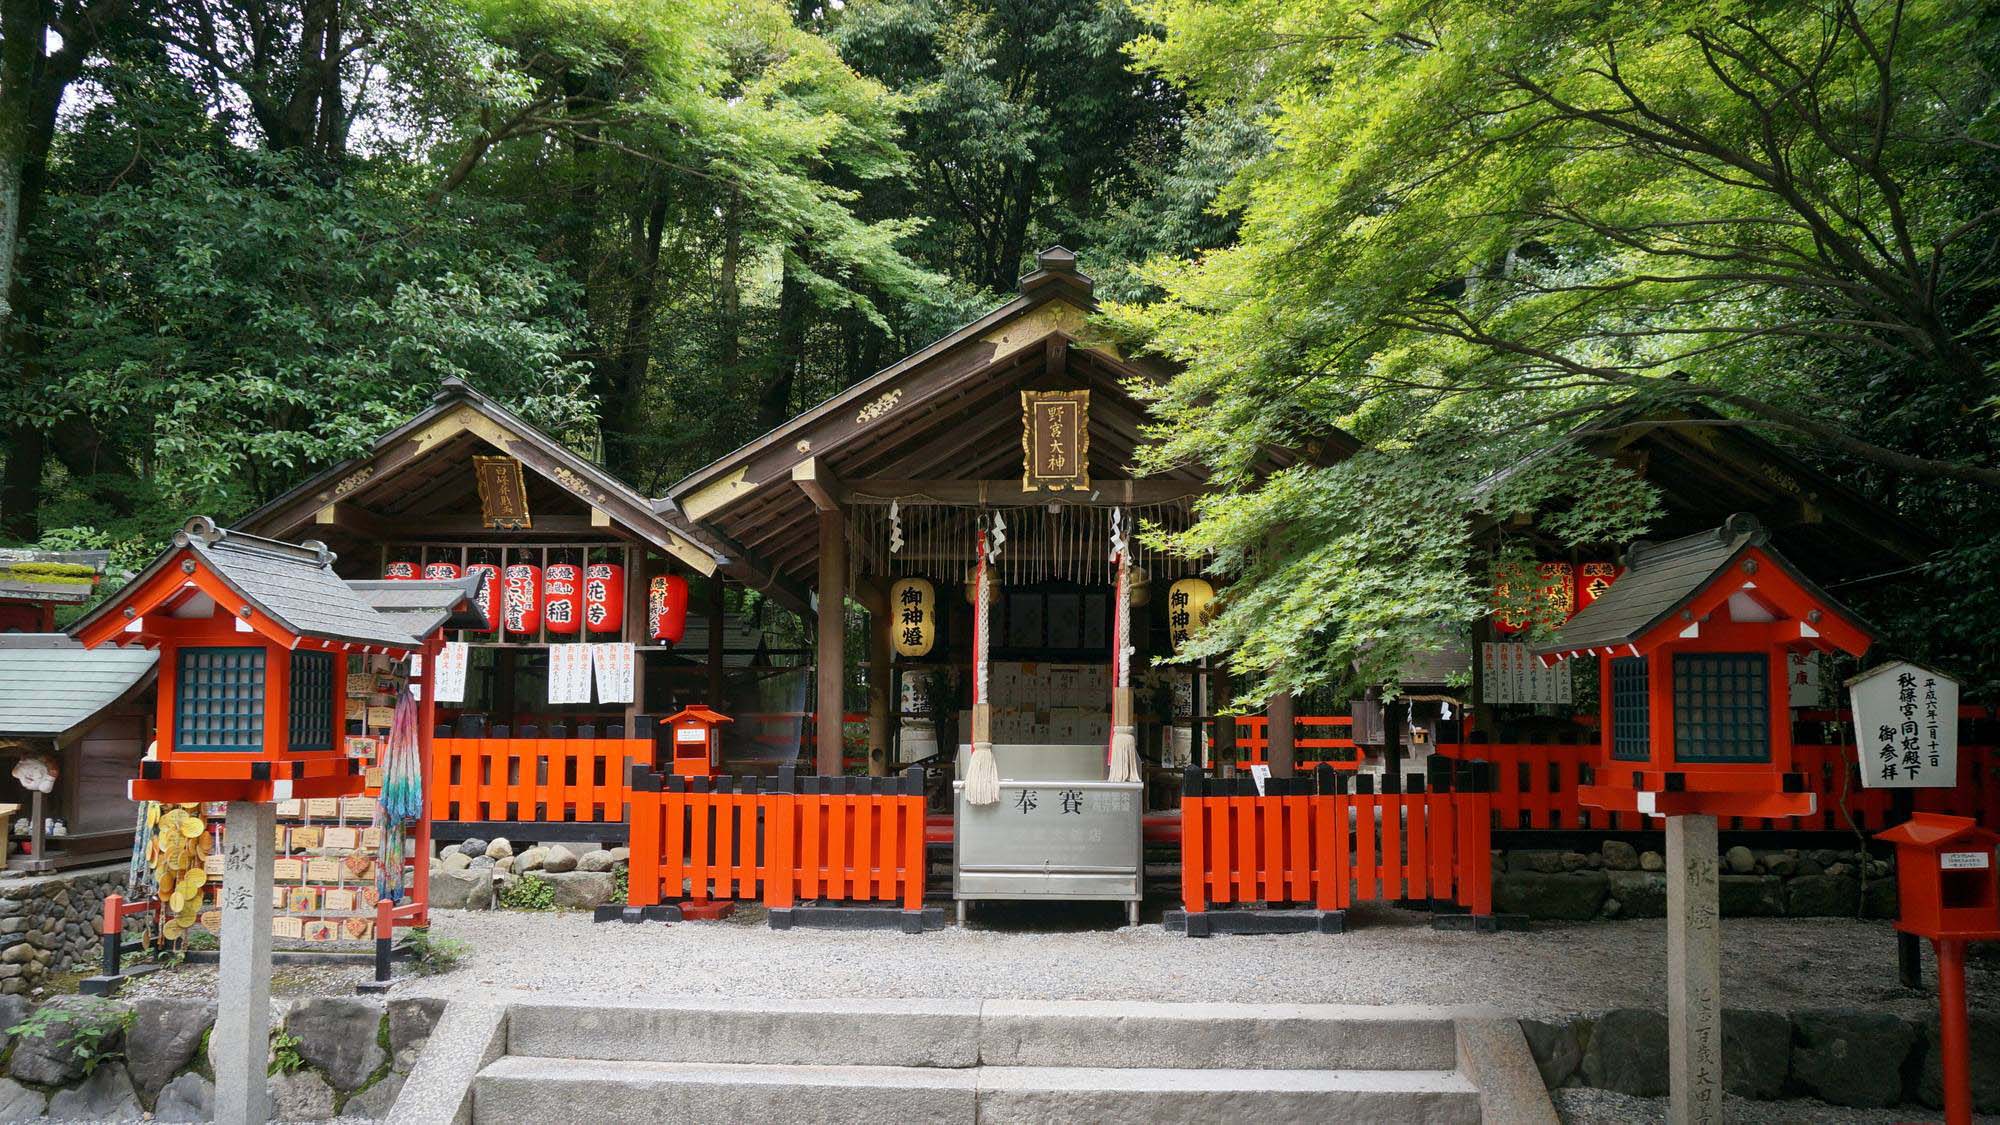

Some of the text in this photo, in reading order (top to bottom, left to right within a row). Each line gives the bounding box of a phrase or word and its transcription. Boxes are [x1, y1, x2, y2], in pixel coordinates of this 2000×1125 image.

[1047, 405, 1065, 471] 野宮大神
[547, 599, 572, 622] 稲
[588, 581, 607, 624] 花芳
[900, 586, 924, 647] 御神燈
[1878, 724, 1899, 781] 御参拝
[1897, 672, 1922, 781] 秋篠宮・同妃殿下
[1923, 678, 1940, 768] 平成六年二月十二日
[225, 845, 254, 911] 献燈
